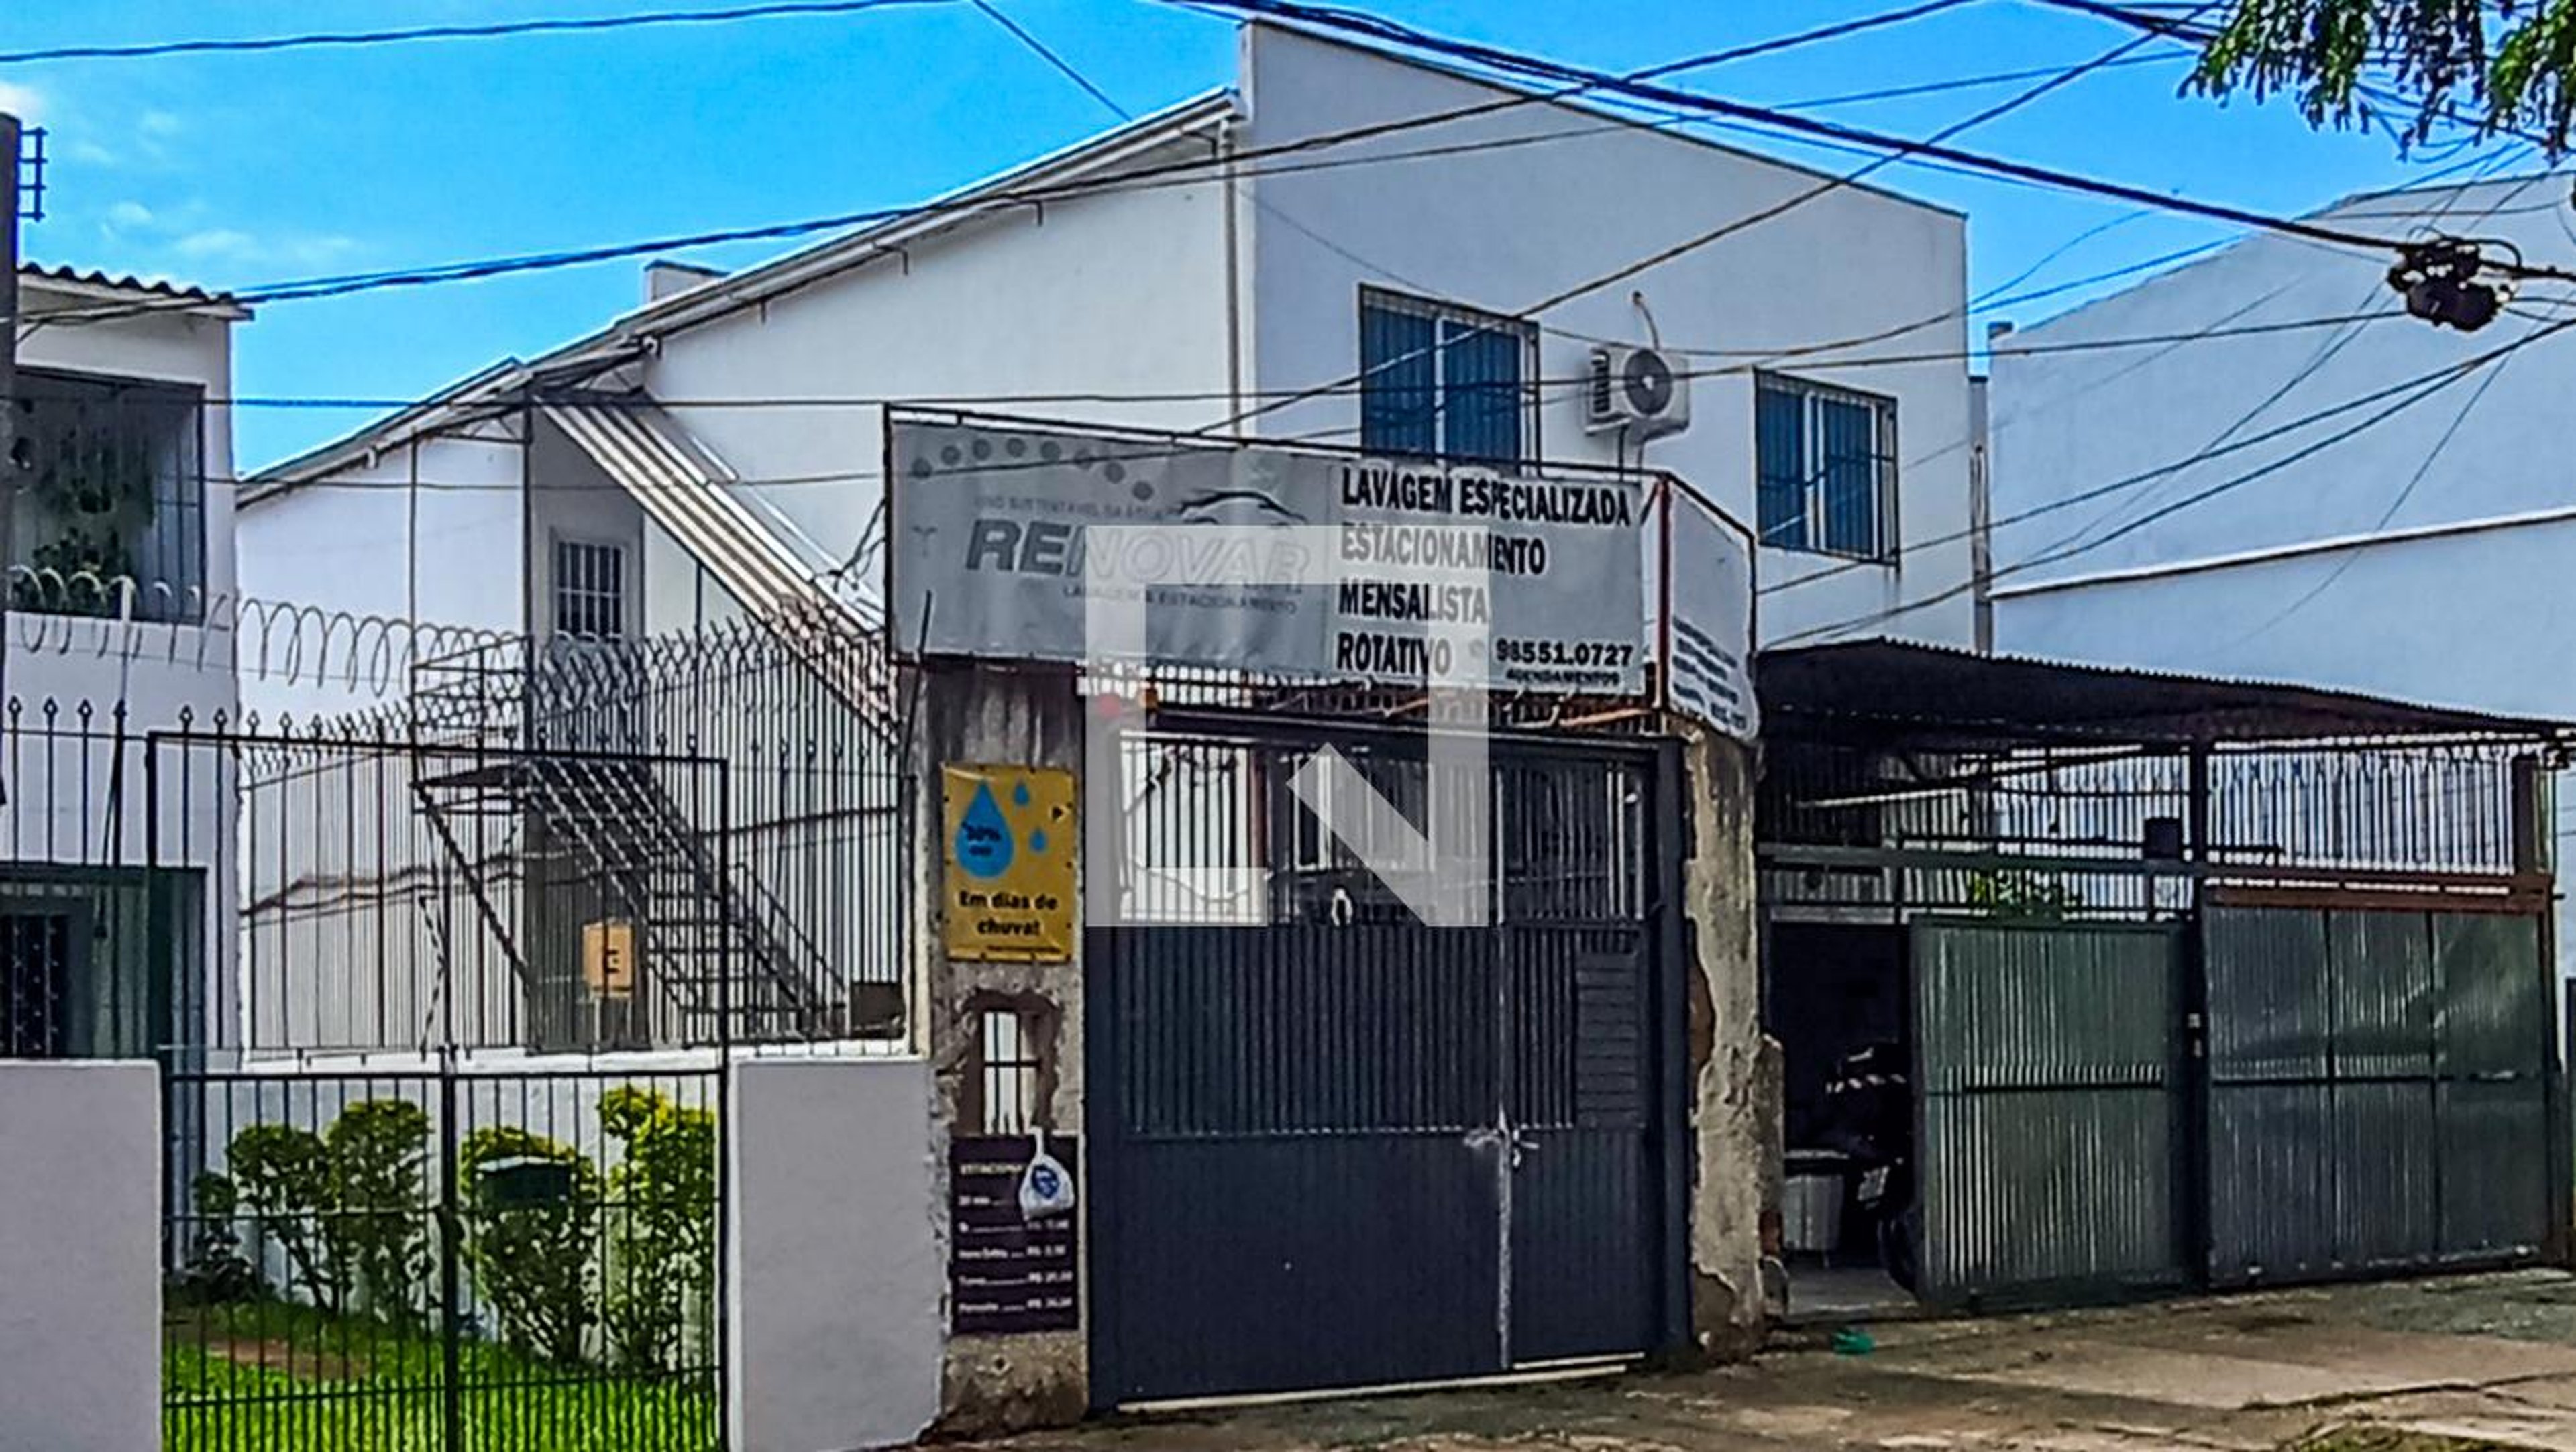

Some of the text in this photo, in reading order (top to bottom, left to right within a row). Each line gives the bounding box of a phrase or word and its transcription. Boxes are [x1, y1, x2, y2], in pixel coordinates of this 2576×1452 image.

[1342, 467, 1631, 527] LAVAGEM ESPECIALIZADA
[966, 519, 1310, 593] RENOVAR
[1342, 522, 1546, 575] ESTACIONAMENTO
[1338, 579, 1488, 624] MENSALISTA
[1336, 632, 1452, 675] ROTATIVO
[959, 890, 1059, 911] Em dias de
[977, 917, 1040, 936] chuva!
